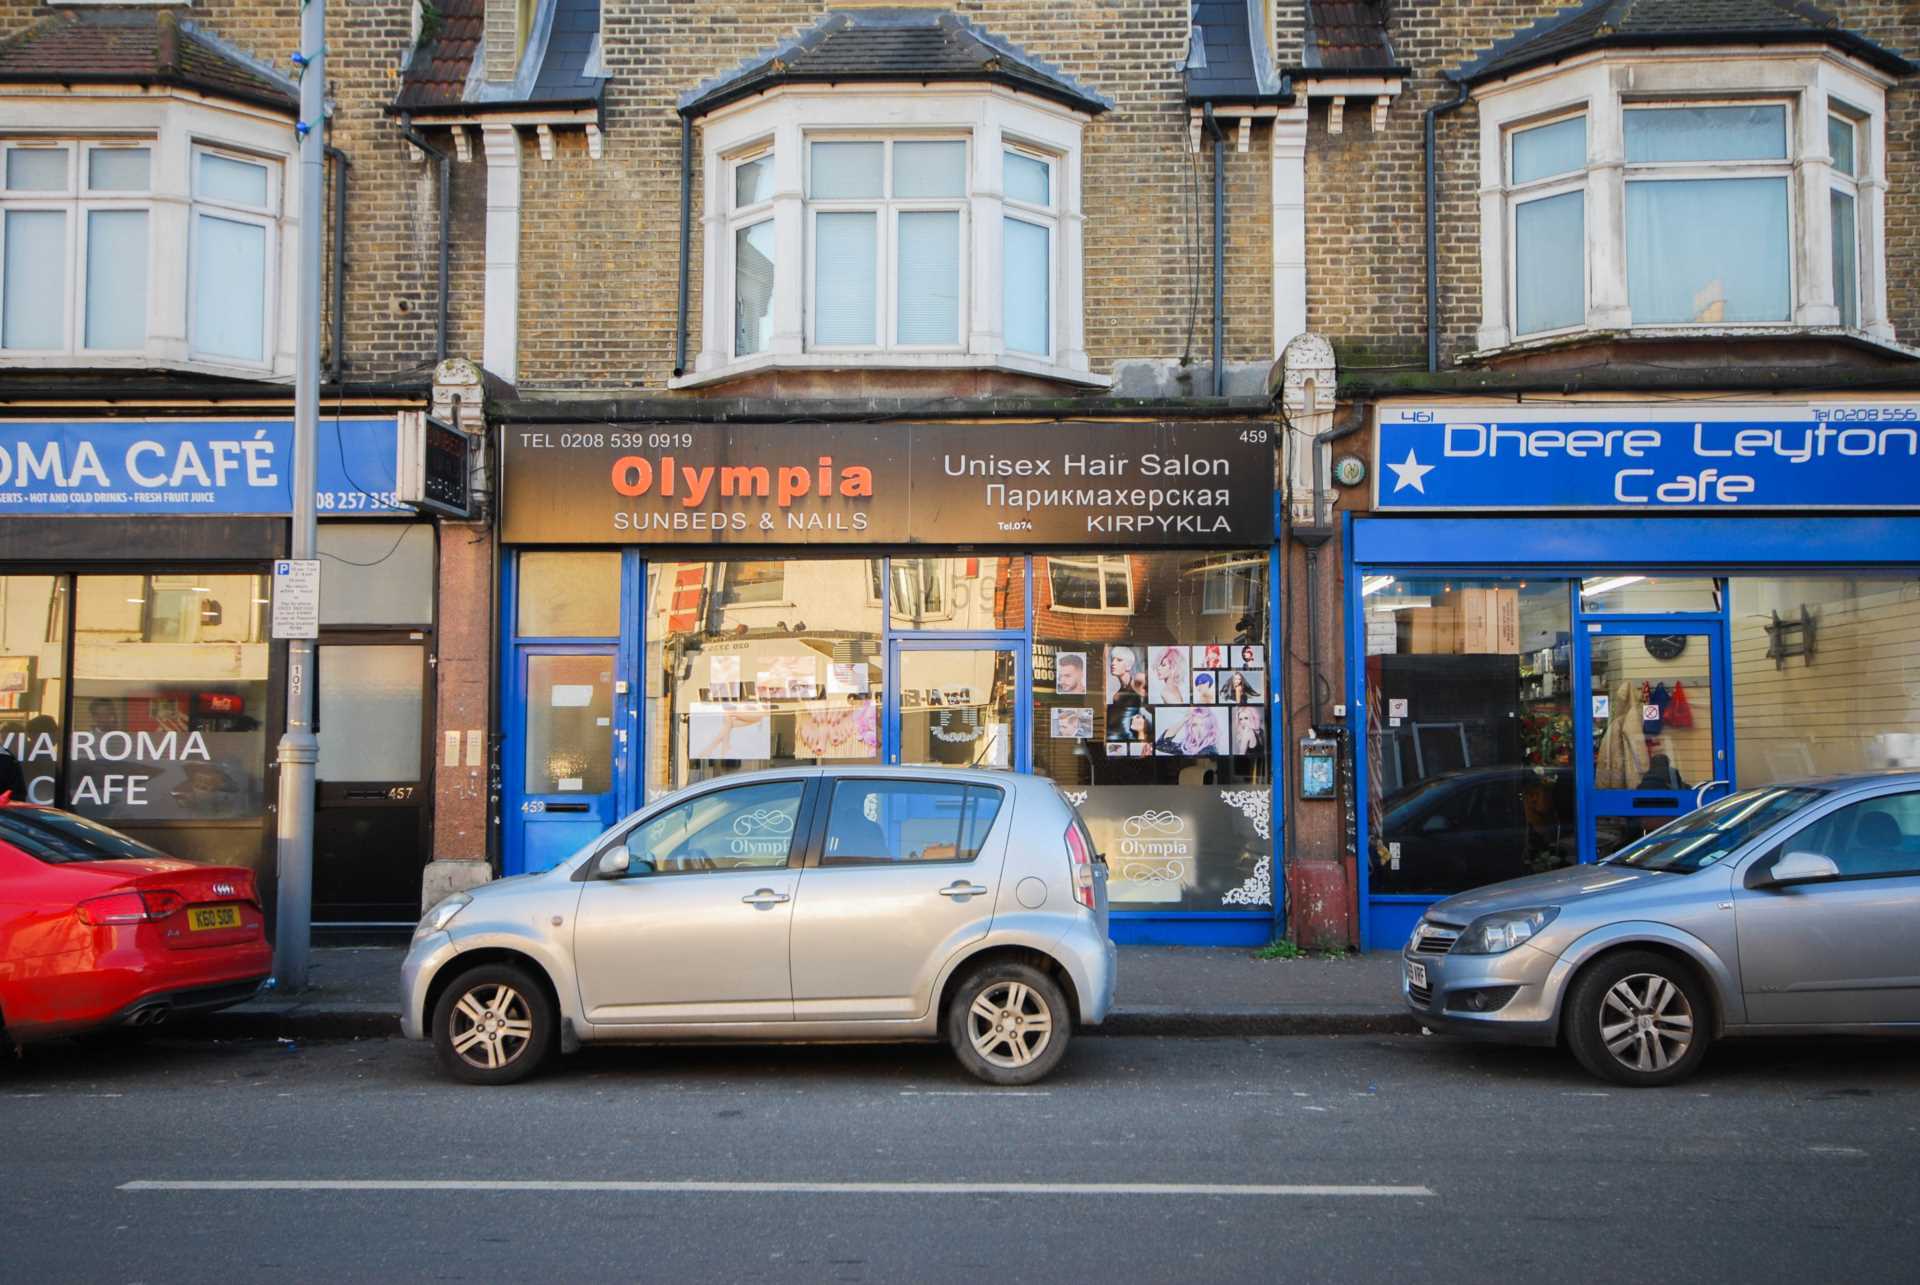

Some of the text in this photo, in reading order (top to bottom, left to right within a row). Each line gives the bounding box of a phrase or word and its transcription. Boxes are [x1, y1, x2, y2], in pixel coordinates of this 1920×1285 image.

[1401, 411, 1434, 422] 461
[1812, 408, 1918, 421] Tel 0208 556
[520, 434, 692, 448] TEL 0208 539 0919
[1240, 430, 1267, 443] 459
[1443, 422, 1918, 463] Dheere Leyton
[0, 429, 278, 487] MA CAFÉ
[944, 455, 1230, 476] Unisex Hair Salon
[611, 456, 873, 507] Olympia
[1614, 469, 1755, 503] Cafe
[30, 493, 48, 503] HOT
[49, 493, 68, 503] AND
[70, 493, 92, 503] COLD
[94, 493, 127, 503] DRINKS
[134, 492, 162, 503] FRESH
[163, 492, 189, 503] FRUIT
[191, 492, 215, 503] JUICE
[338, 492, 366, 508] 257
[986, 484, 1230, 511] Парикмахерская
[614, 512, 868, 530] SUNBEDS & NAILS
[1087, 515, 1231, 532] KIRPYKLA
[71, 730, 211, 761] ROMA
[389, 787, 413, 799] 457
[521, 800, 545, 813] 459
[731, 839, 790, 856] Olympi
[1121, 840, 1187, 857] Olympia
